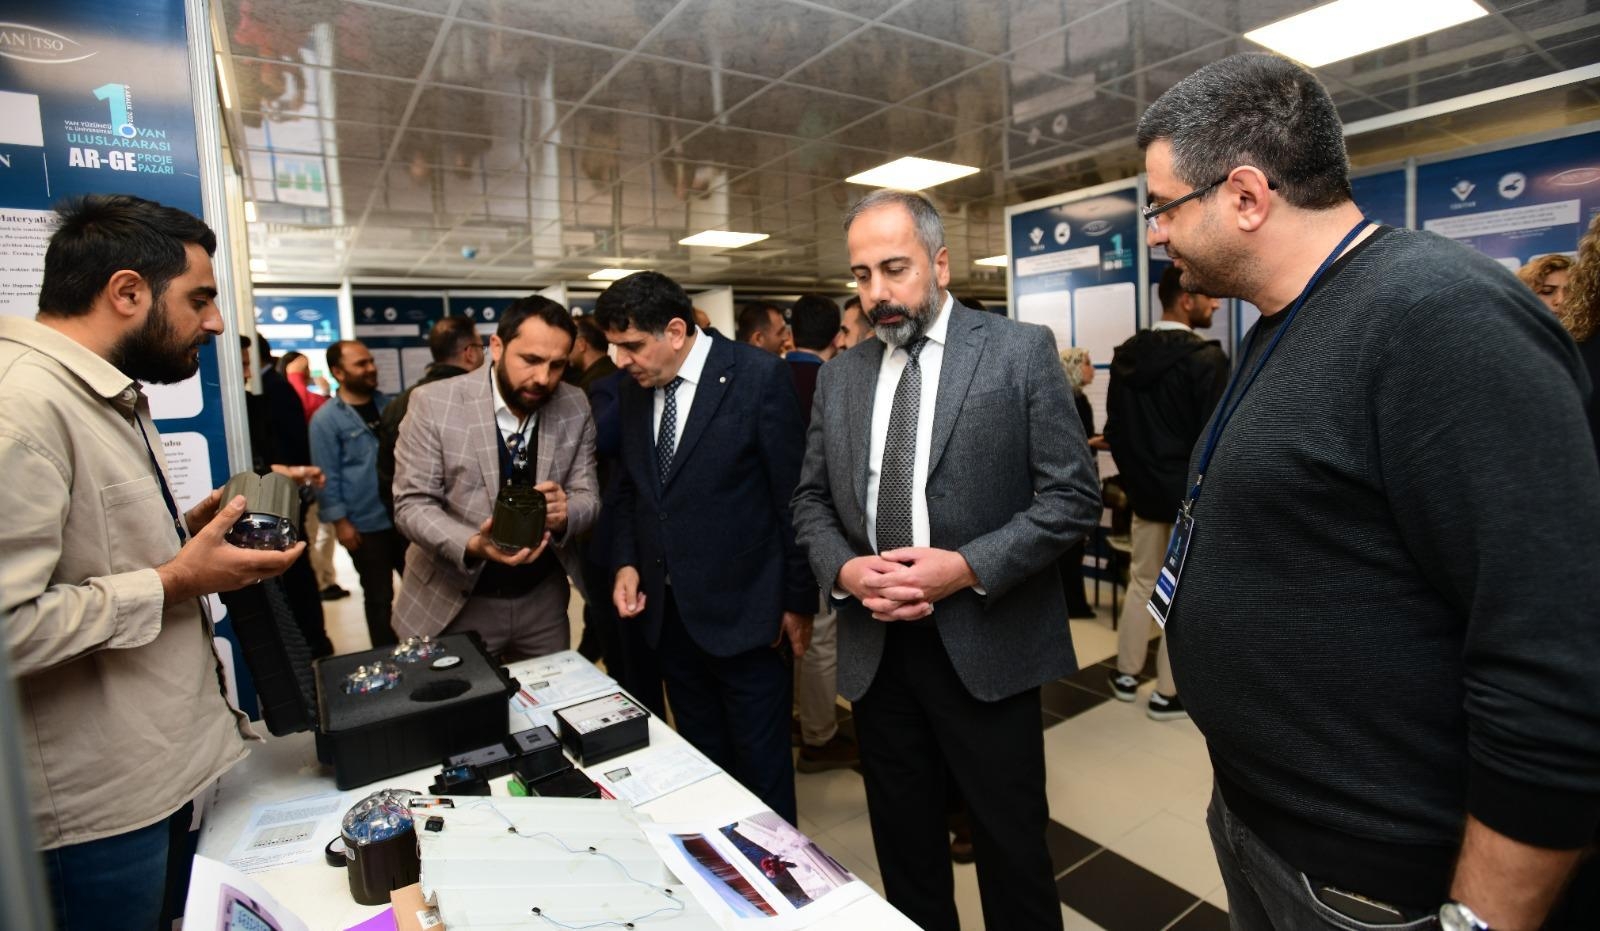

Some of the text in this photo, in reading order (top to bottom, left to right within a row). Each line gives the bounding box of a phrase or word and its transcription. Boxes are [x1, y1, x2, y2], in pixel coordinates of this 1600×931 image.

[33, 36, 64, 51] TSO
[136, 128, 166, 138] VAN
[67, 133, 171, 151] ULUSLARARASI
[69, 147, 138, 172] AR-GE
[137, 153, 173, 165] PROJE
[138, 163, 175, 175] PAZARI
